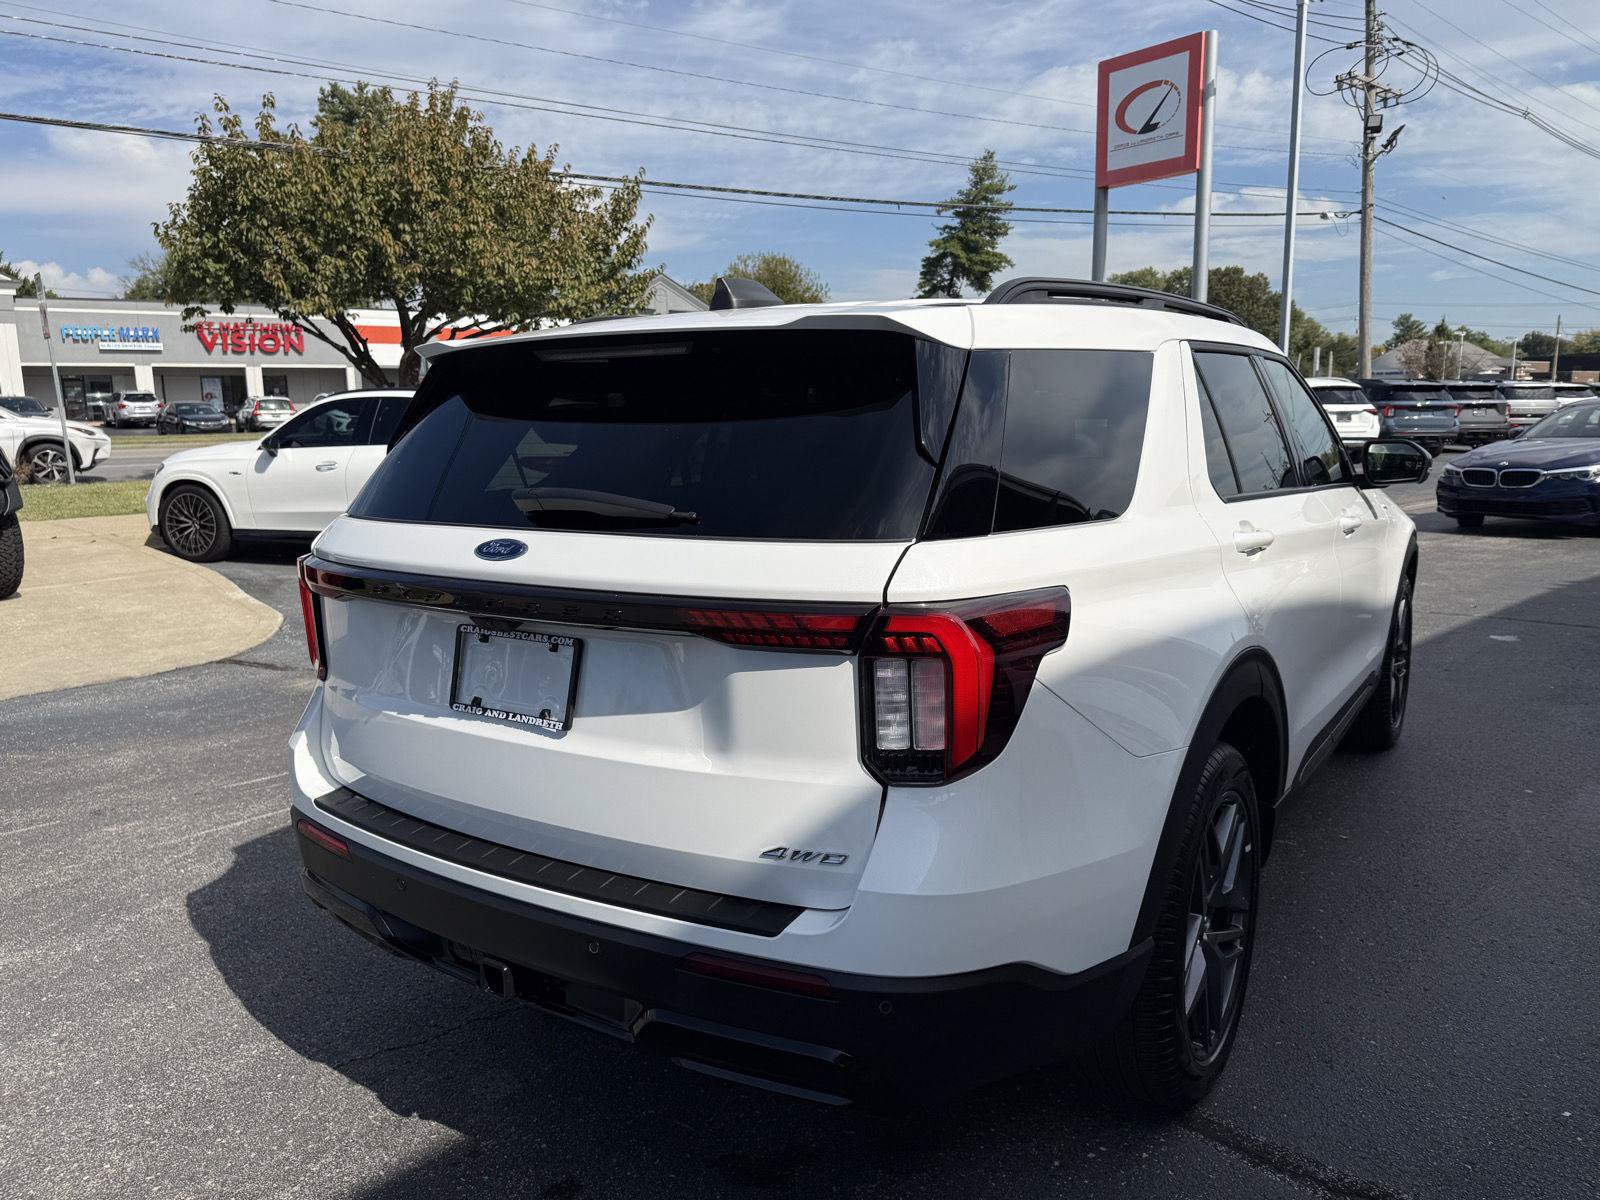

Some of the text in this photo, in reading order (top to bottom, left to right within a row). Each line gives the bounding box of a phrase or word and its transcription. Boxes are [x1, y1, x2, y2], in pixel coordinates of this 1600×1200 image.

[119, 326, 160, 341] MARK
[219, 321, 303, 334] MATTHEWS
[199, 332, 304, 353] VISION
[452, 703, 564, 730] CRAIG AND LANDRETH
[759, 847, 849, 865] 4WD
